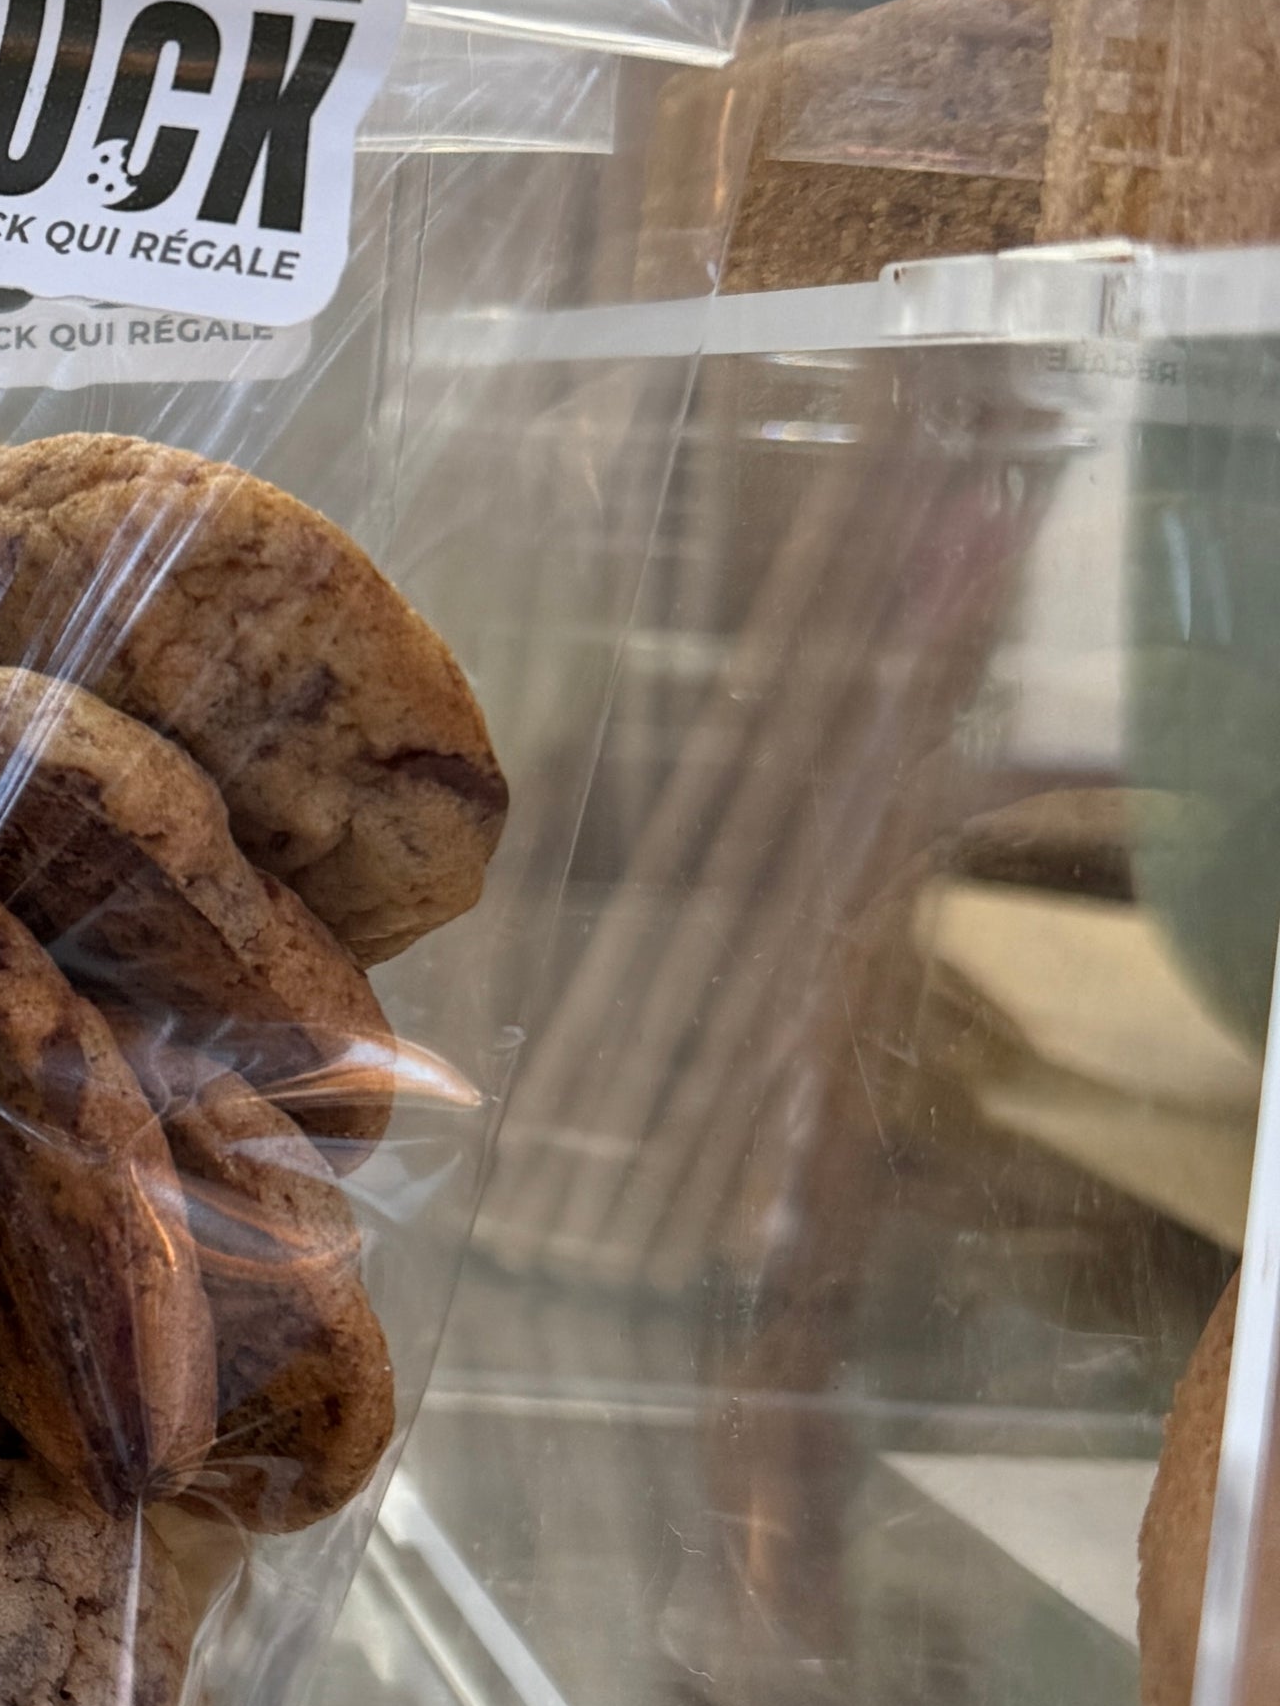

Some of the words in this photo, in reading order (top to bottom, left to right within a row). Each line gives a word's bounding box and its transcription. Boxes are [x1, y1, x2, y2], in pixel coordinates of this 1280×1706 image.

[46, 220, 121, 255] QUI
[129, 229, 300, 281] RÉGALE
[49, 320, 114, 352] QUI
[128, 314, 274, 345] RÉGALE
